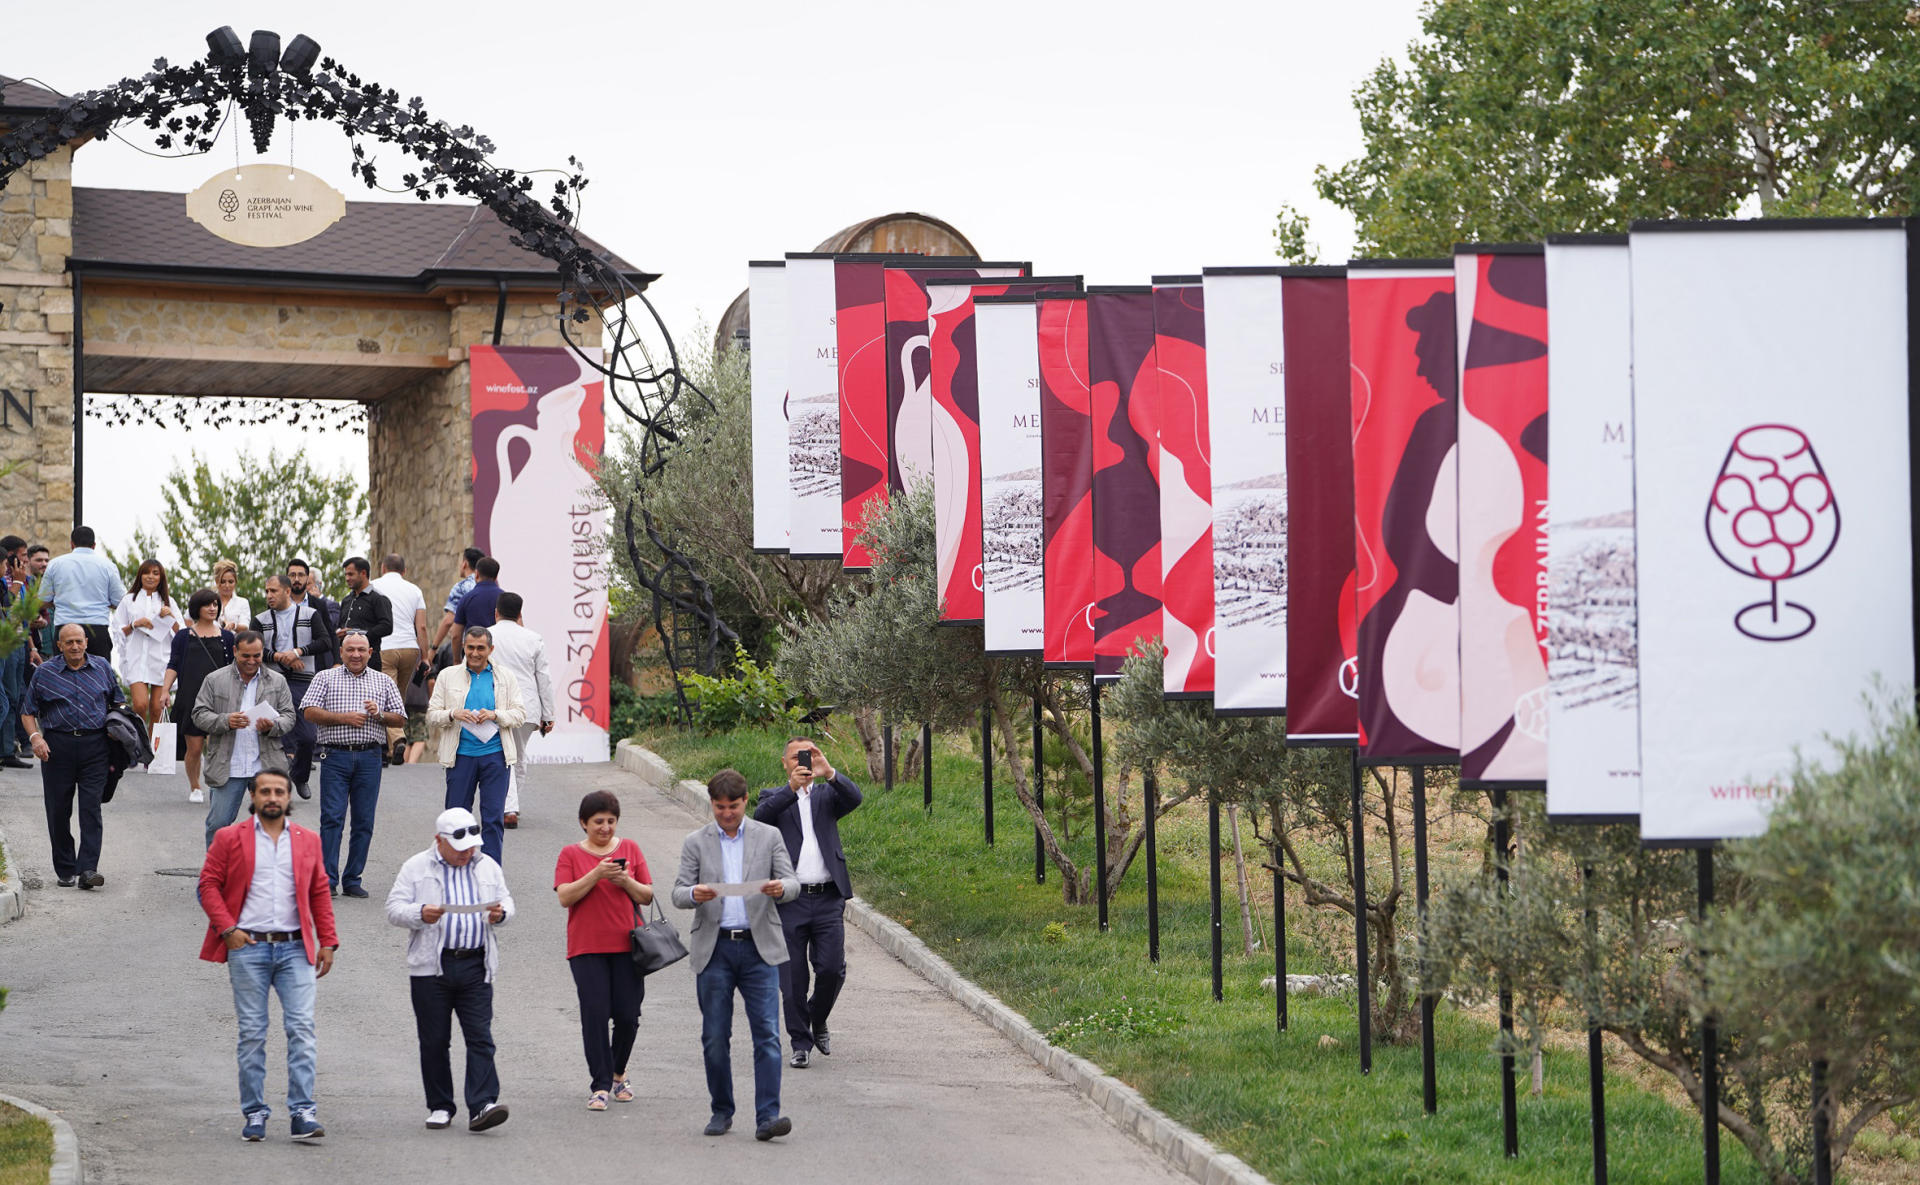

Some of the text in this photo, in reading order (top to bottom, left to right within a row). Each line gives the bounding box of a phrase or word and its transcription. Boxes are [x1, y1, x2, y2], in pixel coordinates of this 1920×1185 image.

[247, 197, 292, 205] AZERBAIJAN
[485, 383, 538, 394] winefest.az
[567, 630, 595, 723] 30-31
